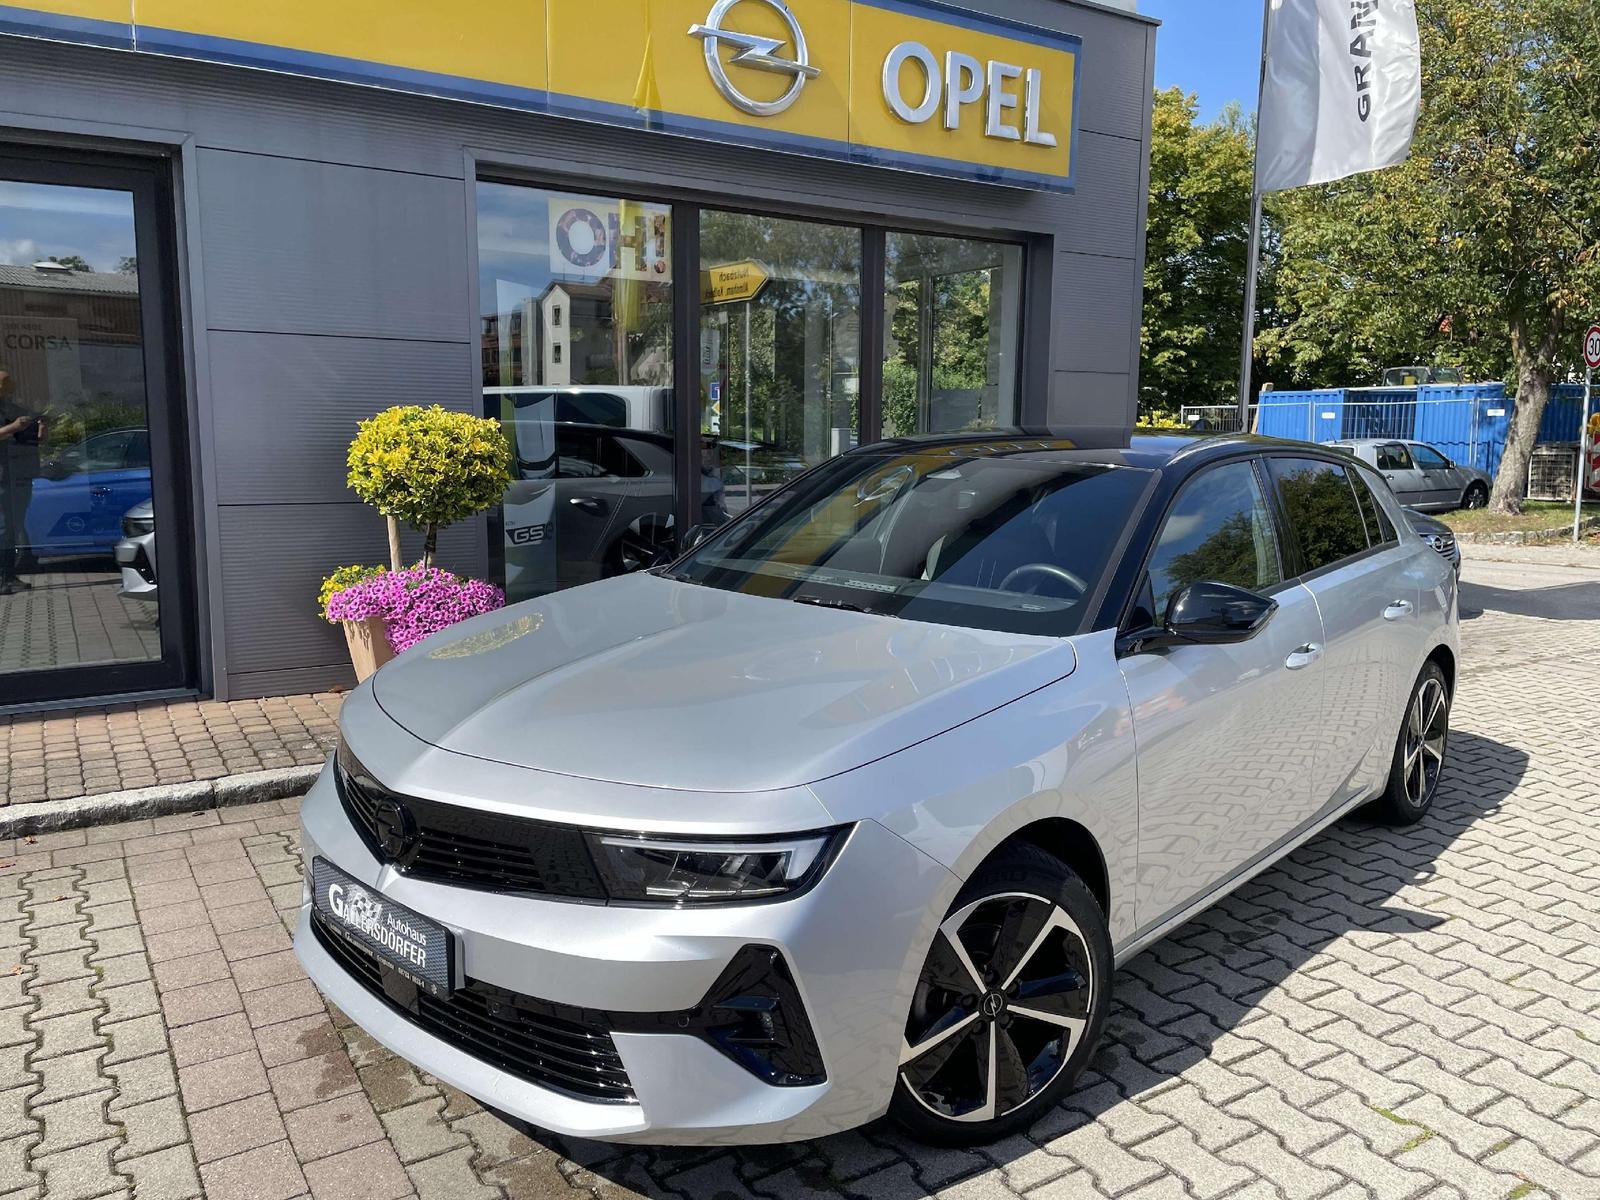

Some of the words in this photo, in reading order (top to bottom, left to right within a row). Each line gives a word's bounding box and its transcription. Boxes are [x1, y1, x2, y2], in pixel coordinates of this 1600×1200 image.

[883, 41, 1057, 147] OPEL
[556, 208, 666, 274] OH!
[5, 334, 72, 352] CORSA
[1588, 337, 1600, 356] 30
[387, 913, 427, 946] Autohaus
